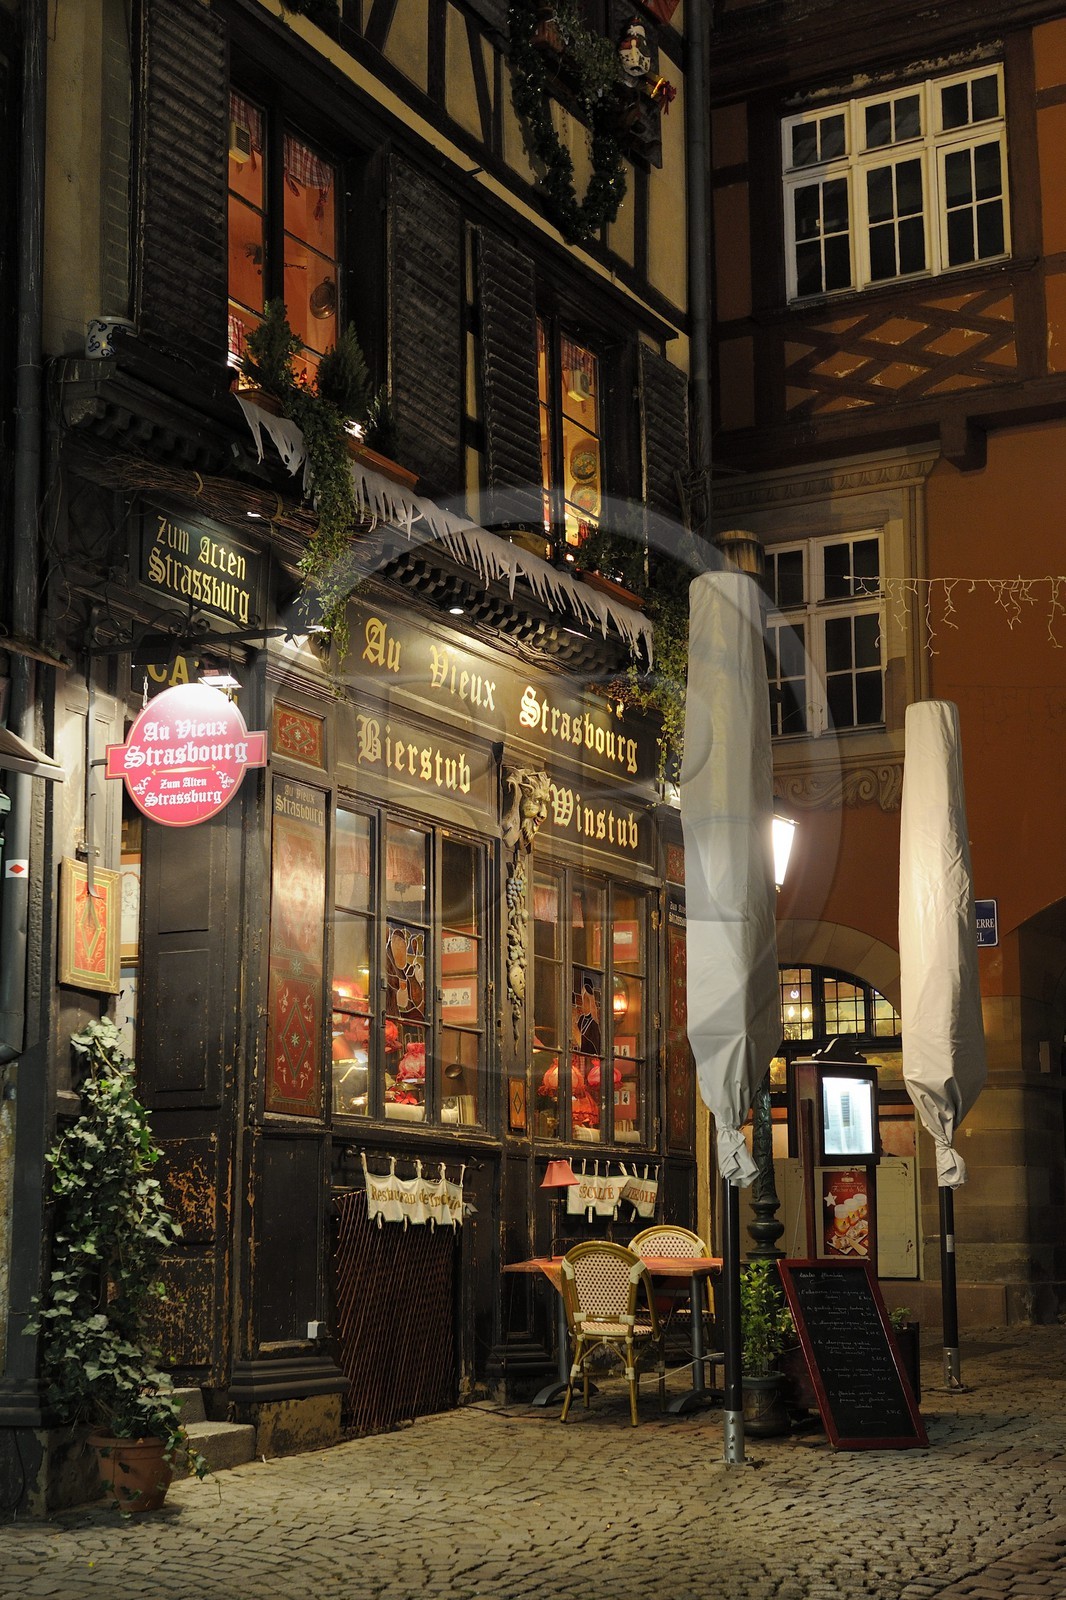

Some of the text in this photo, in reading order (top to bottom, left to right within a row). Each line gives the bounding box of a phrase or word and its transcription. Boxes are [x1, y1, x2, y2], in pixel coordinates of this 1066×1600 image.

[156, 516, 190, 555] Zum
[148, 547, 250, 624] Strassburg
[361, 617, 639, 775] Au Vieux Strasbourg
[143, 719, 228, 742] Au Vieux
[123, 741, 249, 769] Strasbourg
[356, 714, 472, 794] Bierstub
[160, 776, 207, 789] Zum Alten
[144, 790, 222, 808] Strassburg
[275, 794, 324, 826] Strasbourg
[550, 784, 639, 850] Winstub
[976, 918, 994, 927] ERRE
